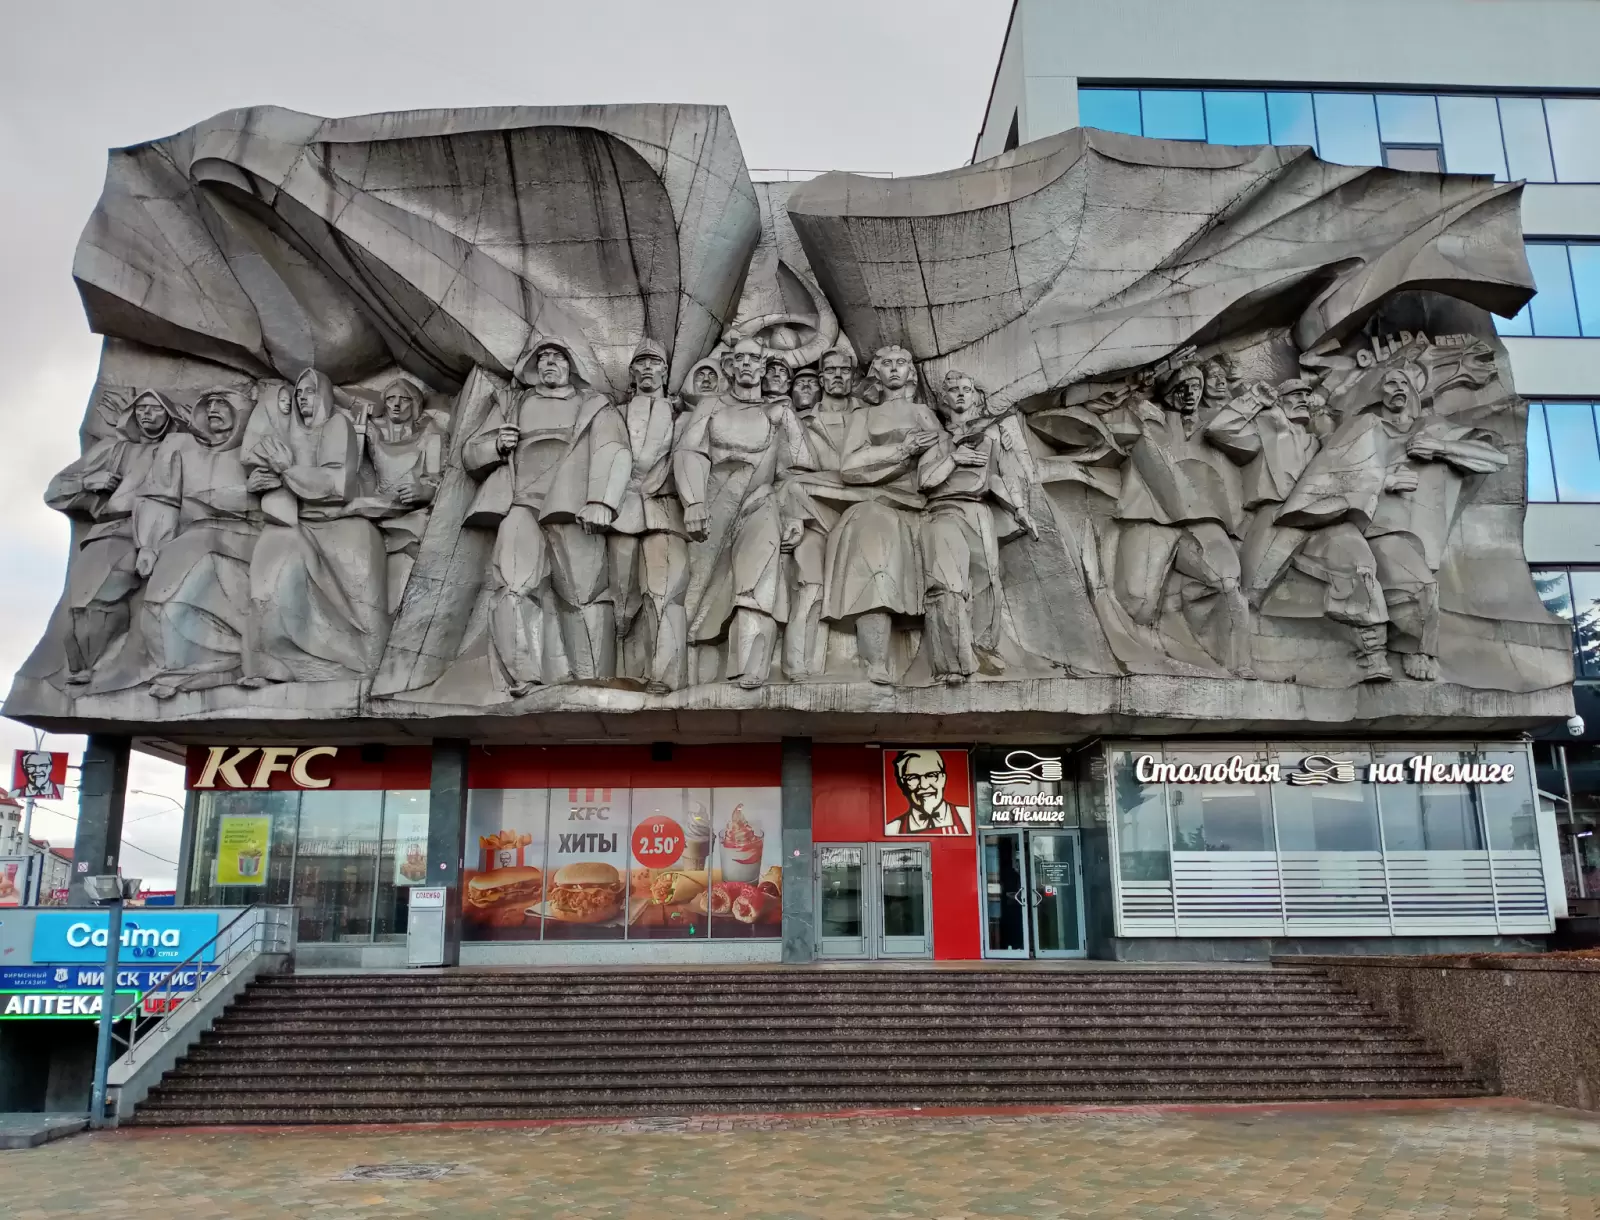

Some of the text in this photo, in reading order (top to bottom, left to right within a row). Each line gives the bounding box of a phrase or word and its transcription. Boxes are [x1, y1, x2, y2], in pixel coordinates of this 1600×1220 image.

[193, 747, 339, 789] KFC
[1135, 755, 1515, 784] Столовая на Немиге
[992, 791, 1064, 806] Столовая
[568, 807, 610, 821] KFC
[992, 807, 1066, 822] на Немиге
[652, 824, 665, 834] ОТ
[558, 833, 617, 853] ХИТЫ
[415, 891, 441, 899] СПАСИБО
[77, 972, 140, 986] МИСК
[4, 995, 103, 1015] АПТЕКА
